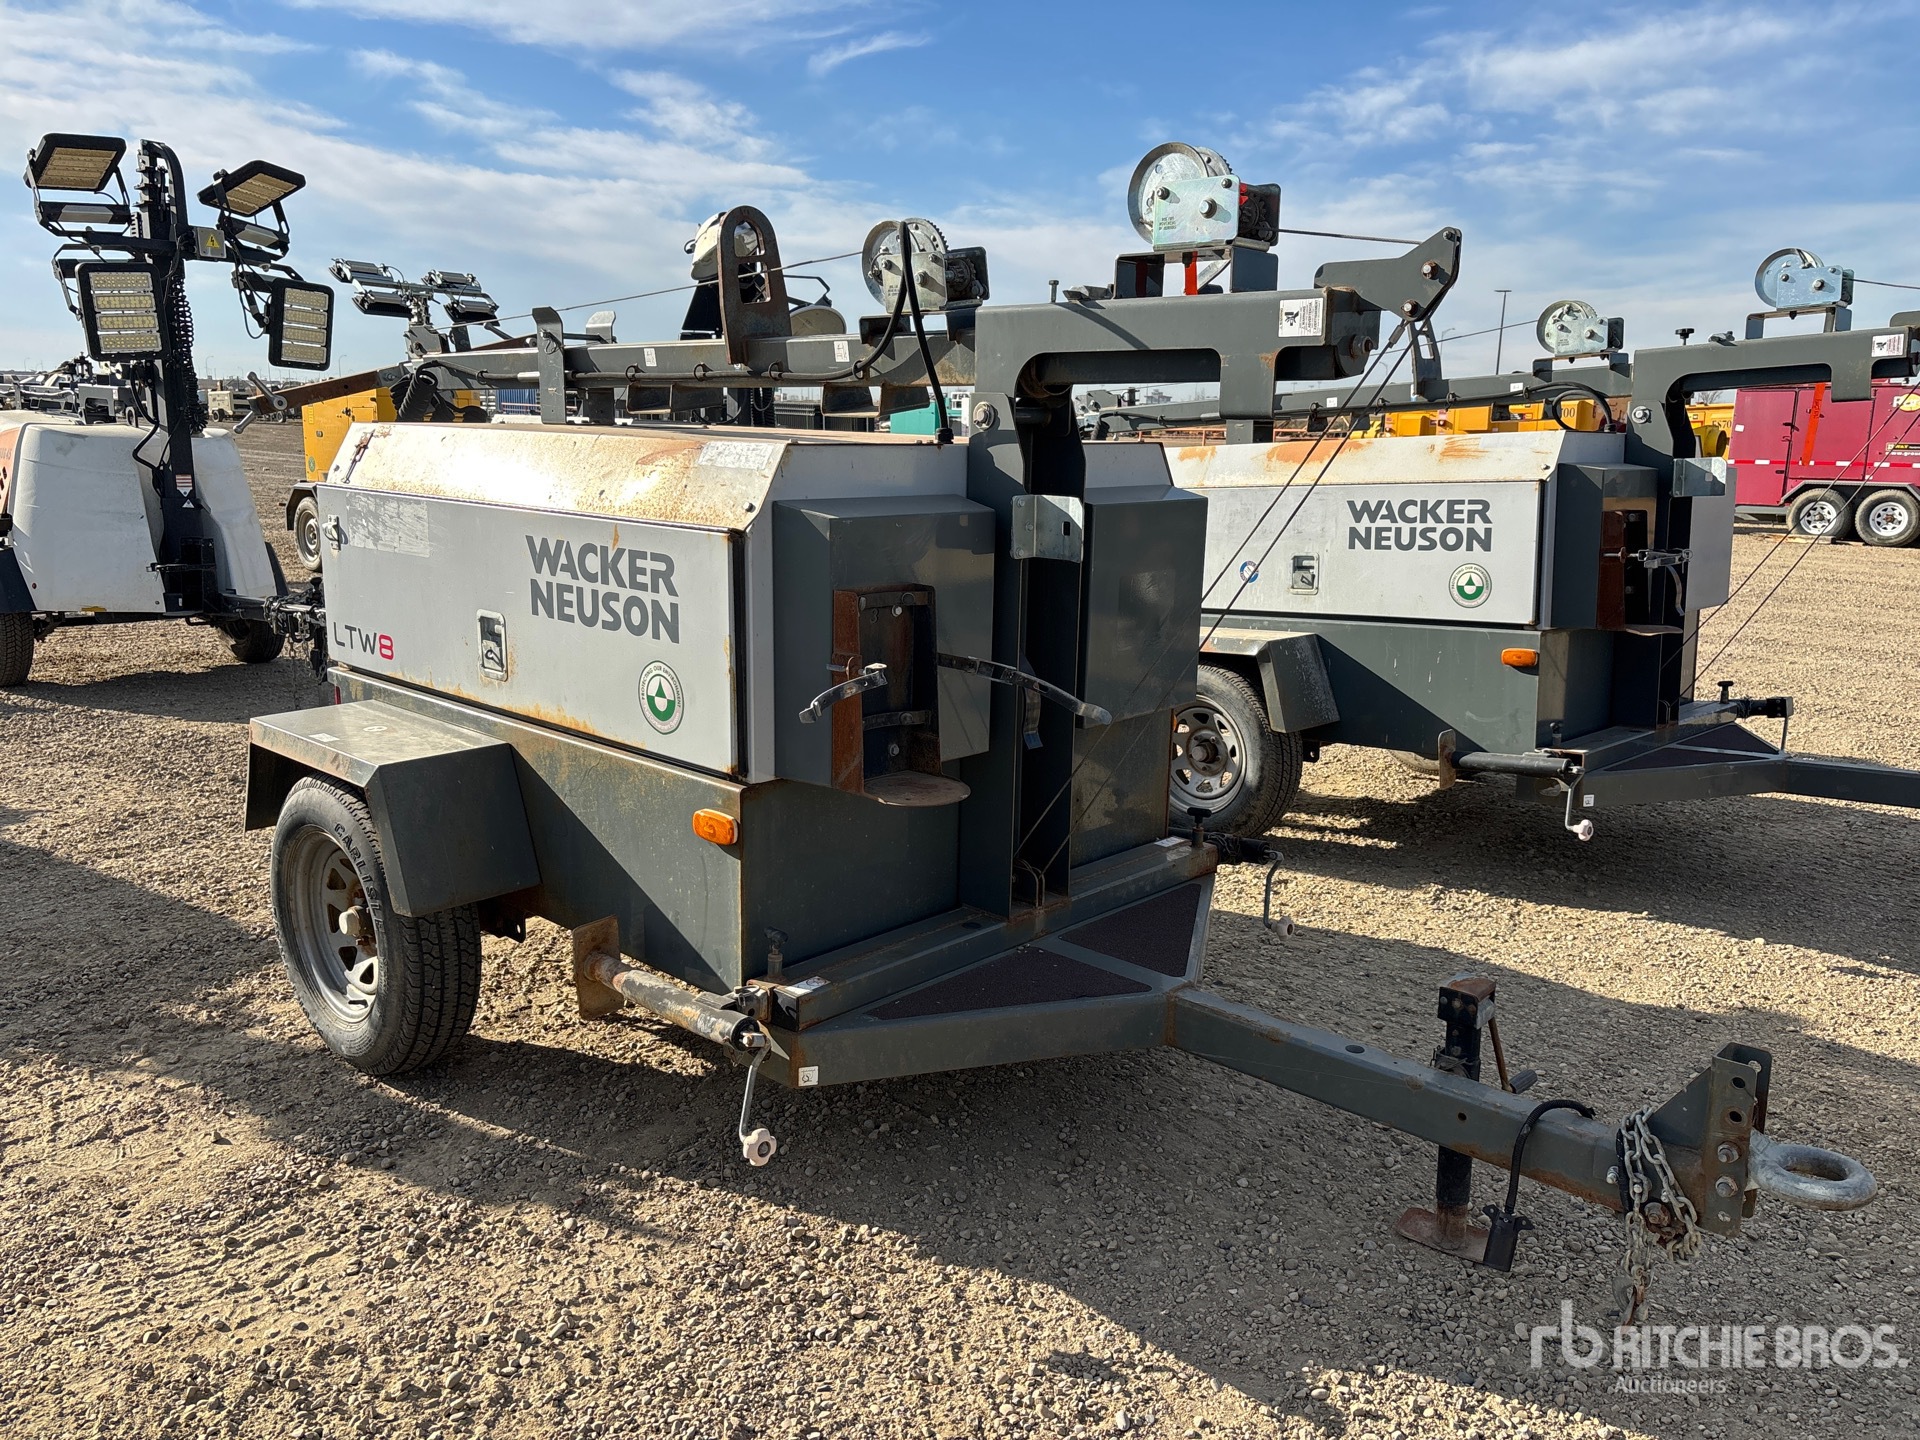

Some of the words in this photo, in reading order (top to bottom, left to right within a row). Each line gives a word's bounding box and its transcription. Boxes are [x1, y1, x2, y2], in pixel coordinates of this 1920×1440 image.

[1346, 499, 1493, 524] WACKER
[1348, 527, 1493, 552] NEUSON
[525, 535, 679, 598] WACKER
[530, 578, 680, 644] NEUSON
[333, 621, 394, 660] LTW8
[640, 667, 654, 700] PROTECTING
[662, 666, 682, 708] ENVIRONMENT
[334, 823, 384, 933] CARLISLE
